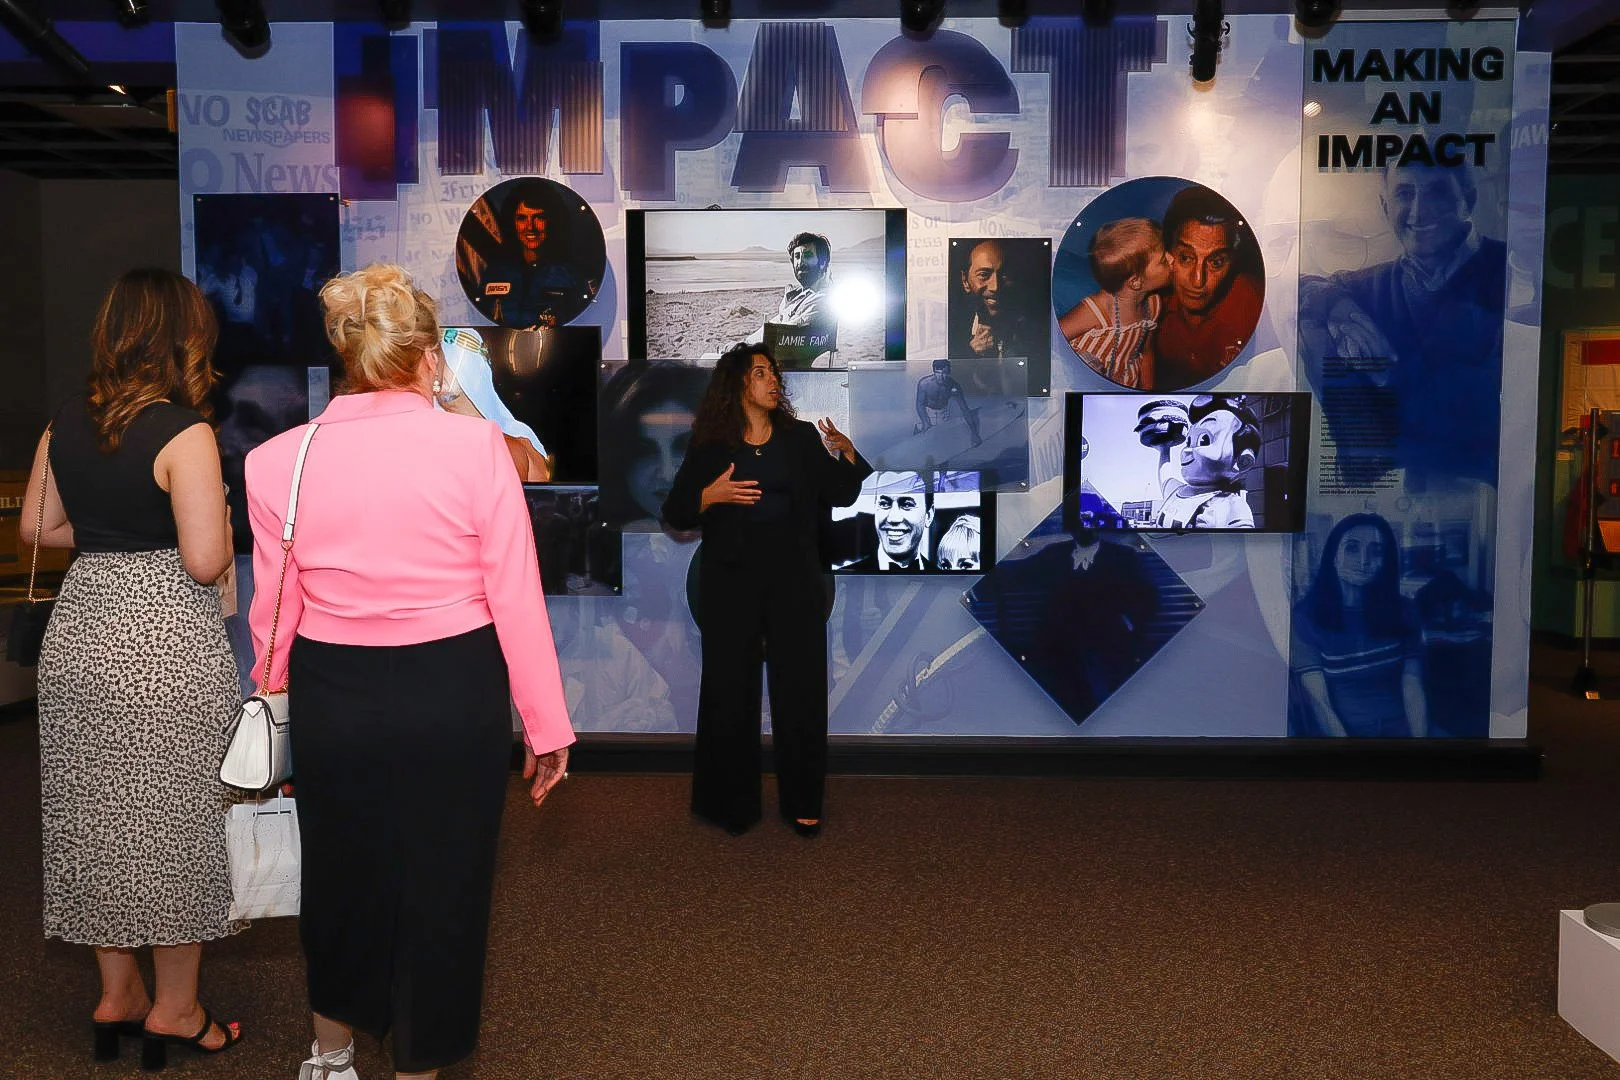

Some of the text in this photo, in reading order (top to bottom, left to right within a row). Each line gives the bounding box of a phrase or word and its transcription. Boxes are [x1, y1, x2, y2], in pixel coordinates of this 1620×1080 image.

[1312, 46, 1505, 83] MAKING
[245, 95, 312, 130] SCAB
[335, 22, 1167, 203] IMPACT
[1370, 91, 1442, 125] AN
[223, 128, 331, 144] NEWSPAPERS
[1318, 133, 1496, 168] IMPACT
[233, 151, 338, 192] News
[778, 335, 805, 347] JAMIE
